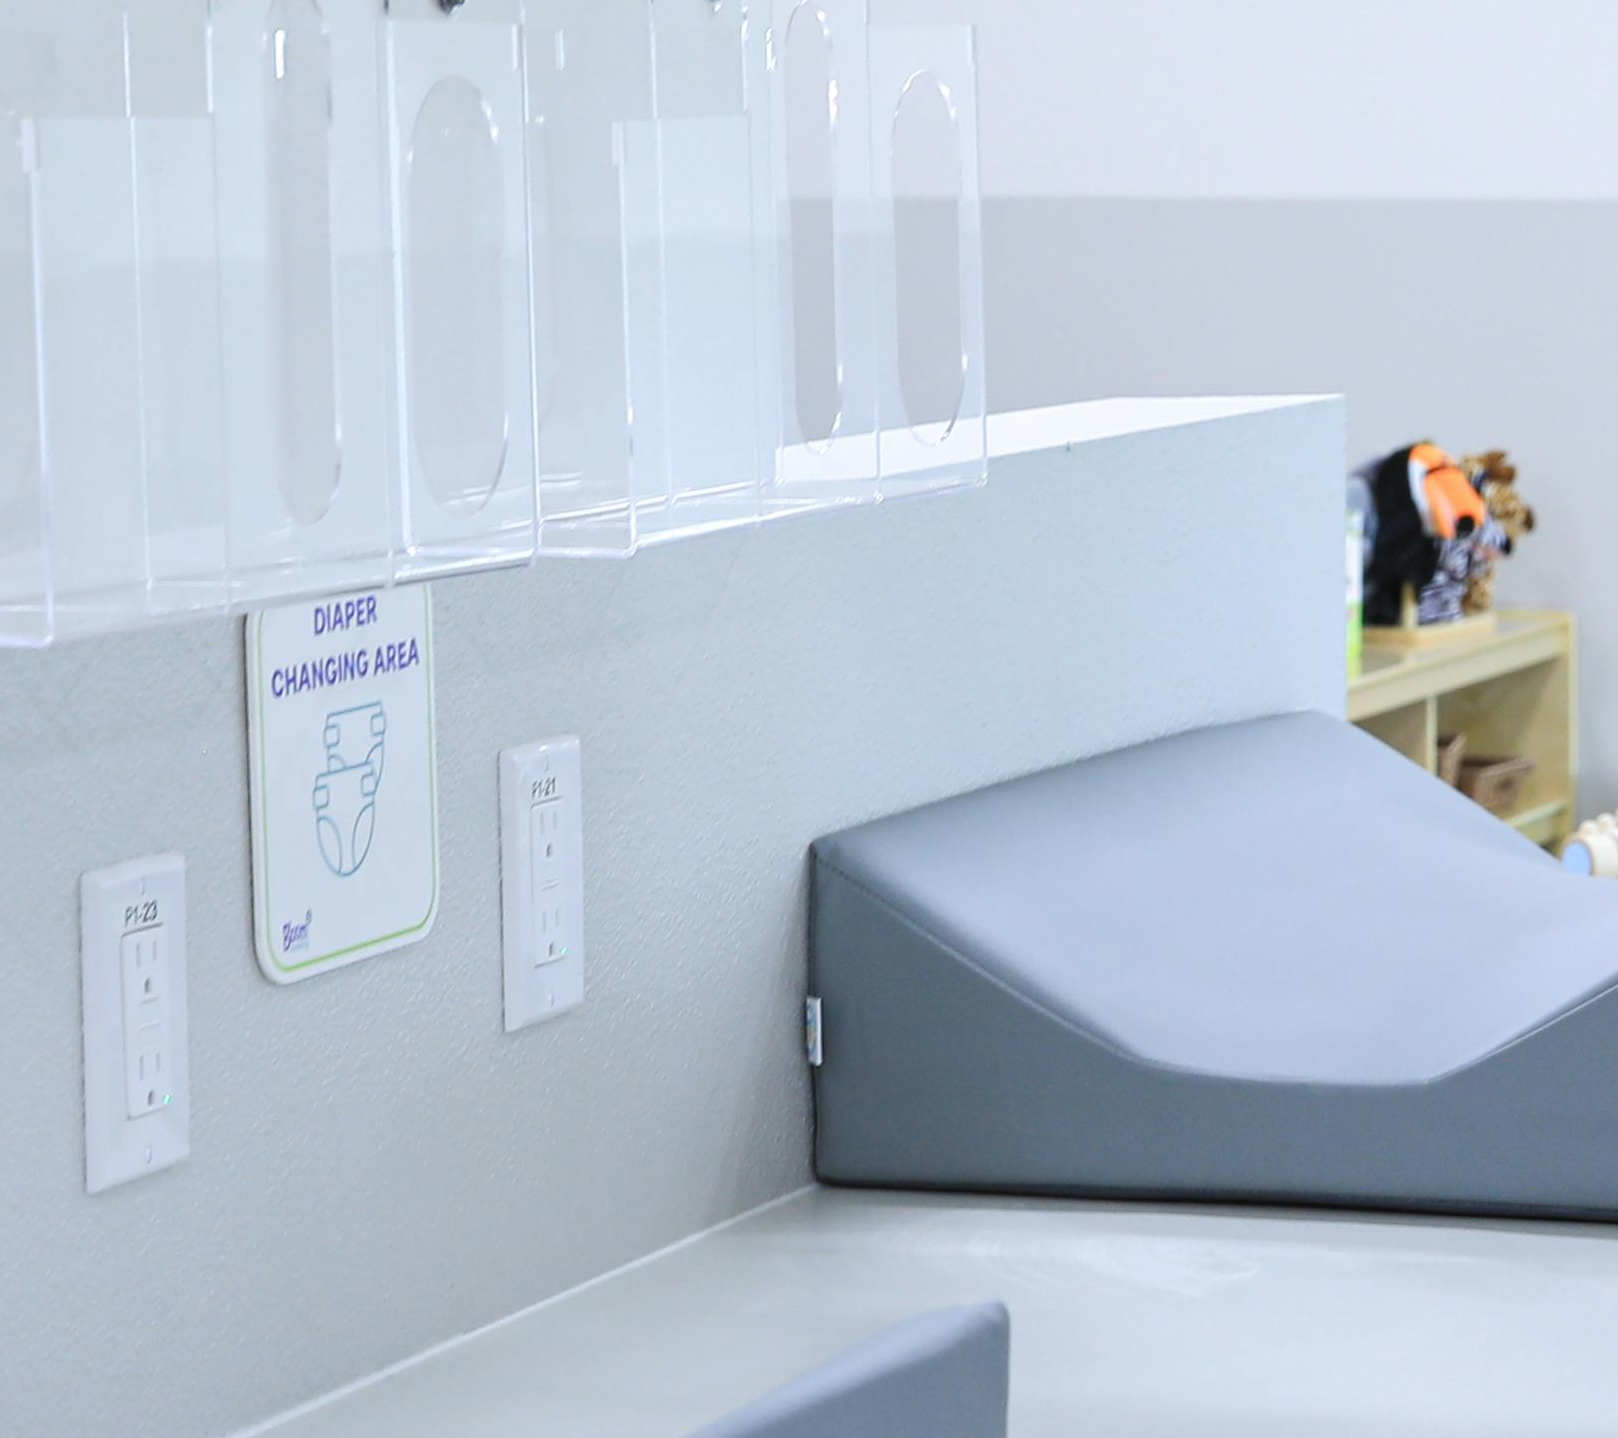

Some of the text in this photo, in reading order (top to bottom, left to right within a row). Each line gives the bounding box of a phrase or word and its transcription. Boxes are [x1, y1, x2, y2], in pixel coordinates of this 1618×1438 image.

[313, 595, 378, 637] DIAPER
[271, 637, 420, 698] CHANGING AREA
